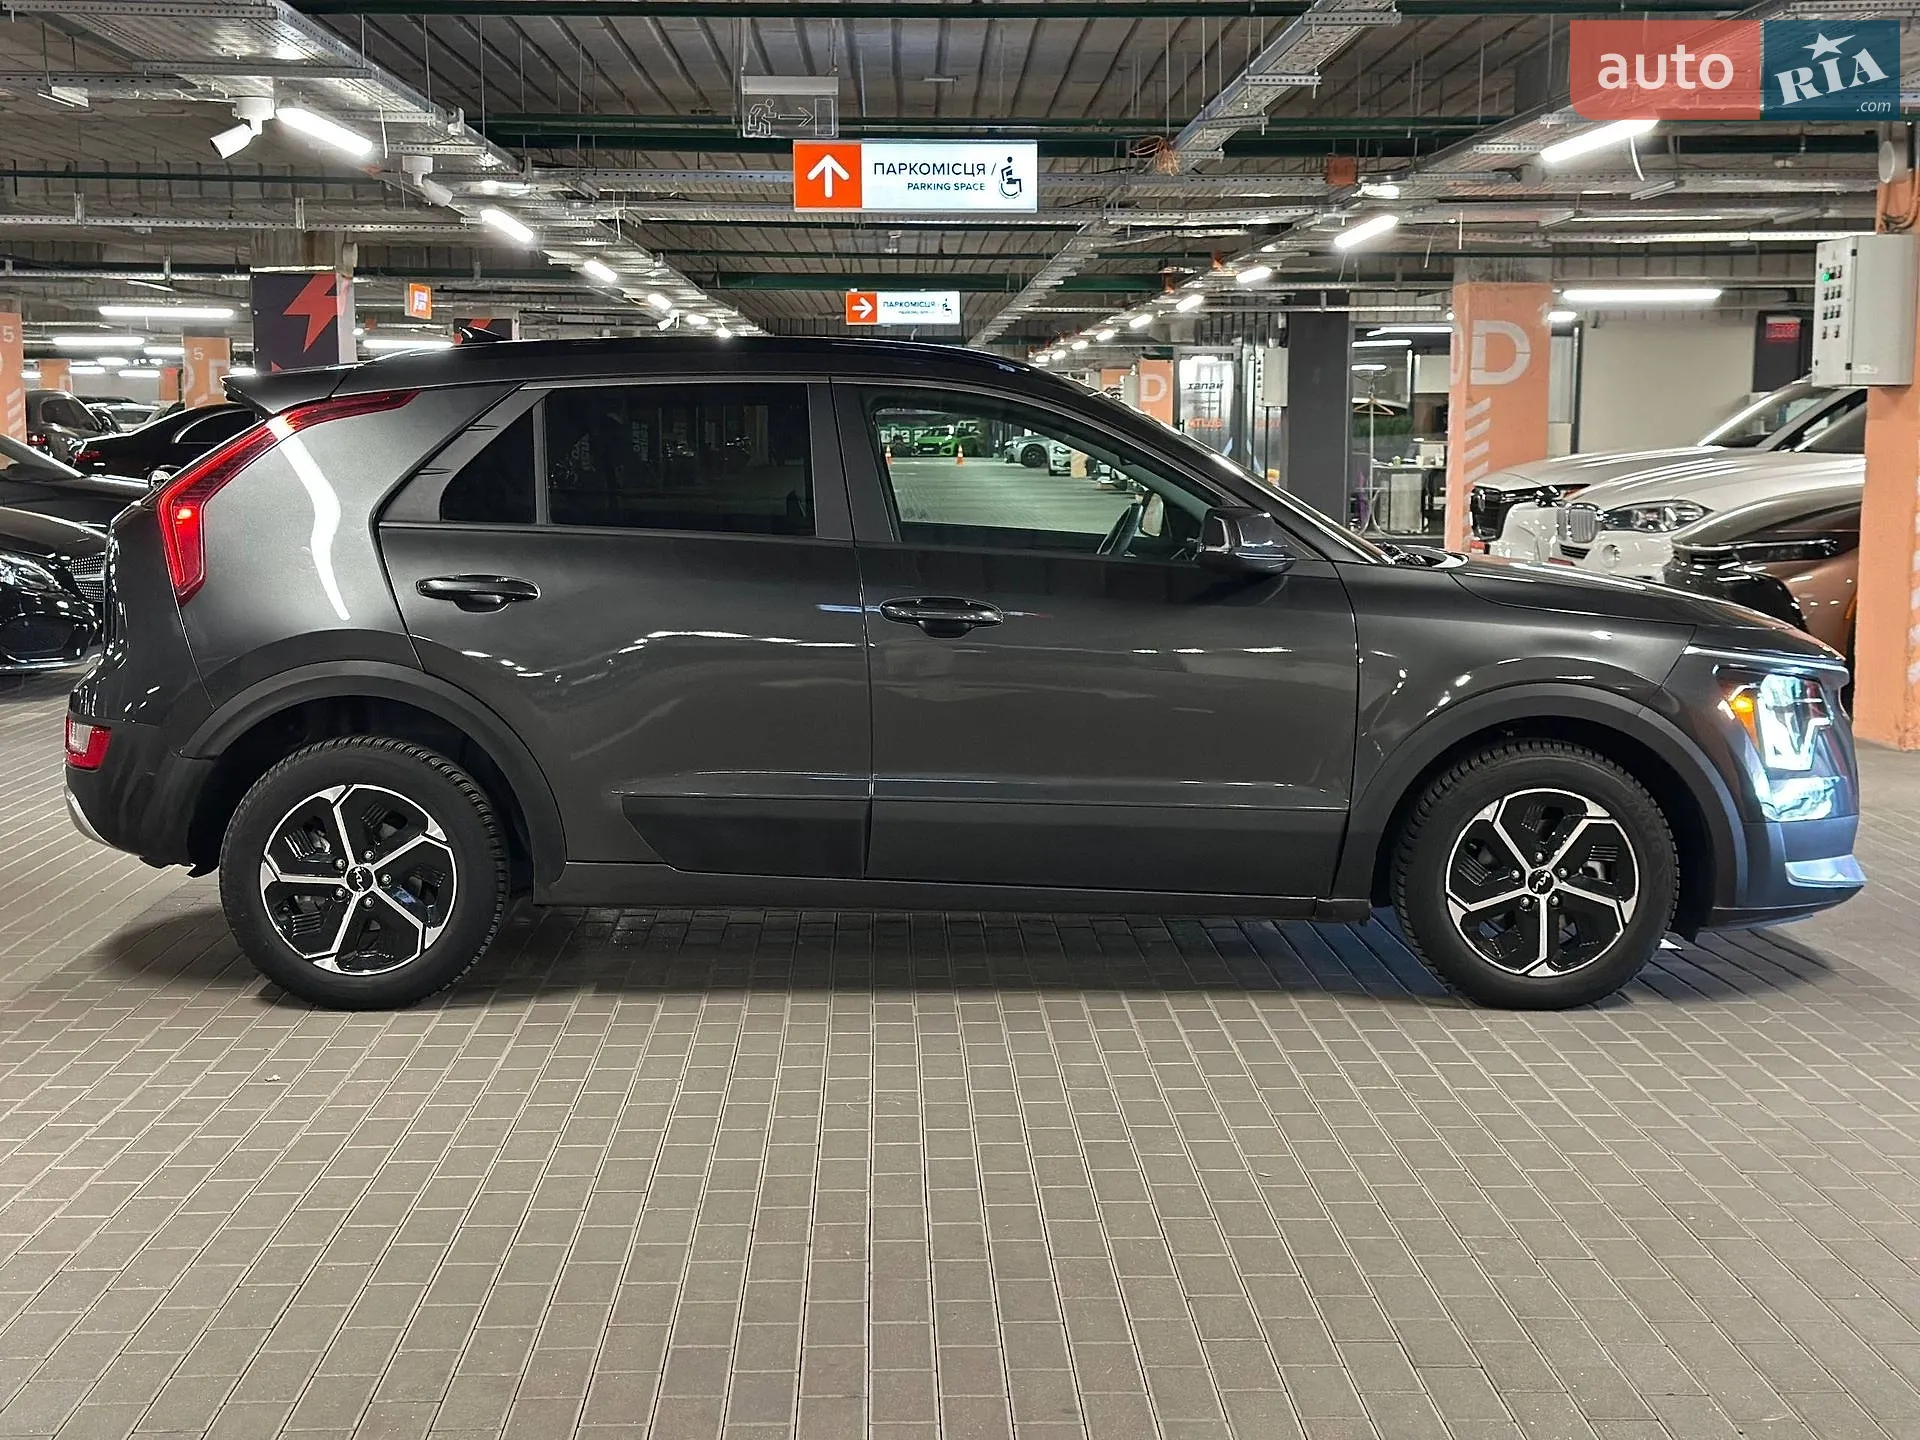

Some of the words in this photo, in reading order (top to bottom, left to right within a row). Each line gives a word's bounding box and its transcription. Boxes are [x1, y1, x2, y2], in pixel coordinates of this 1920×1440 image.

[873, 162, 986, 177] ПАРКОМІСЦЯ
[907, 182, 951, 191] PARKING
[954, 182, 986, 191] SPACE
